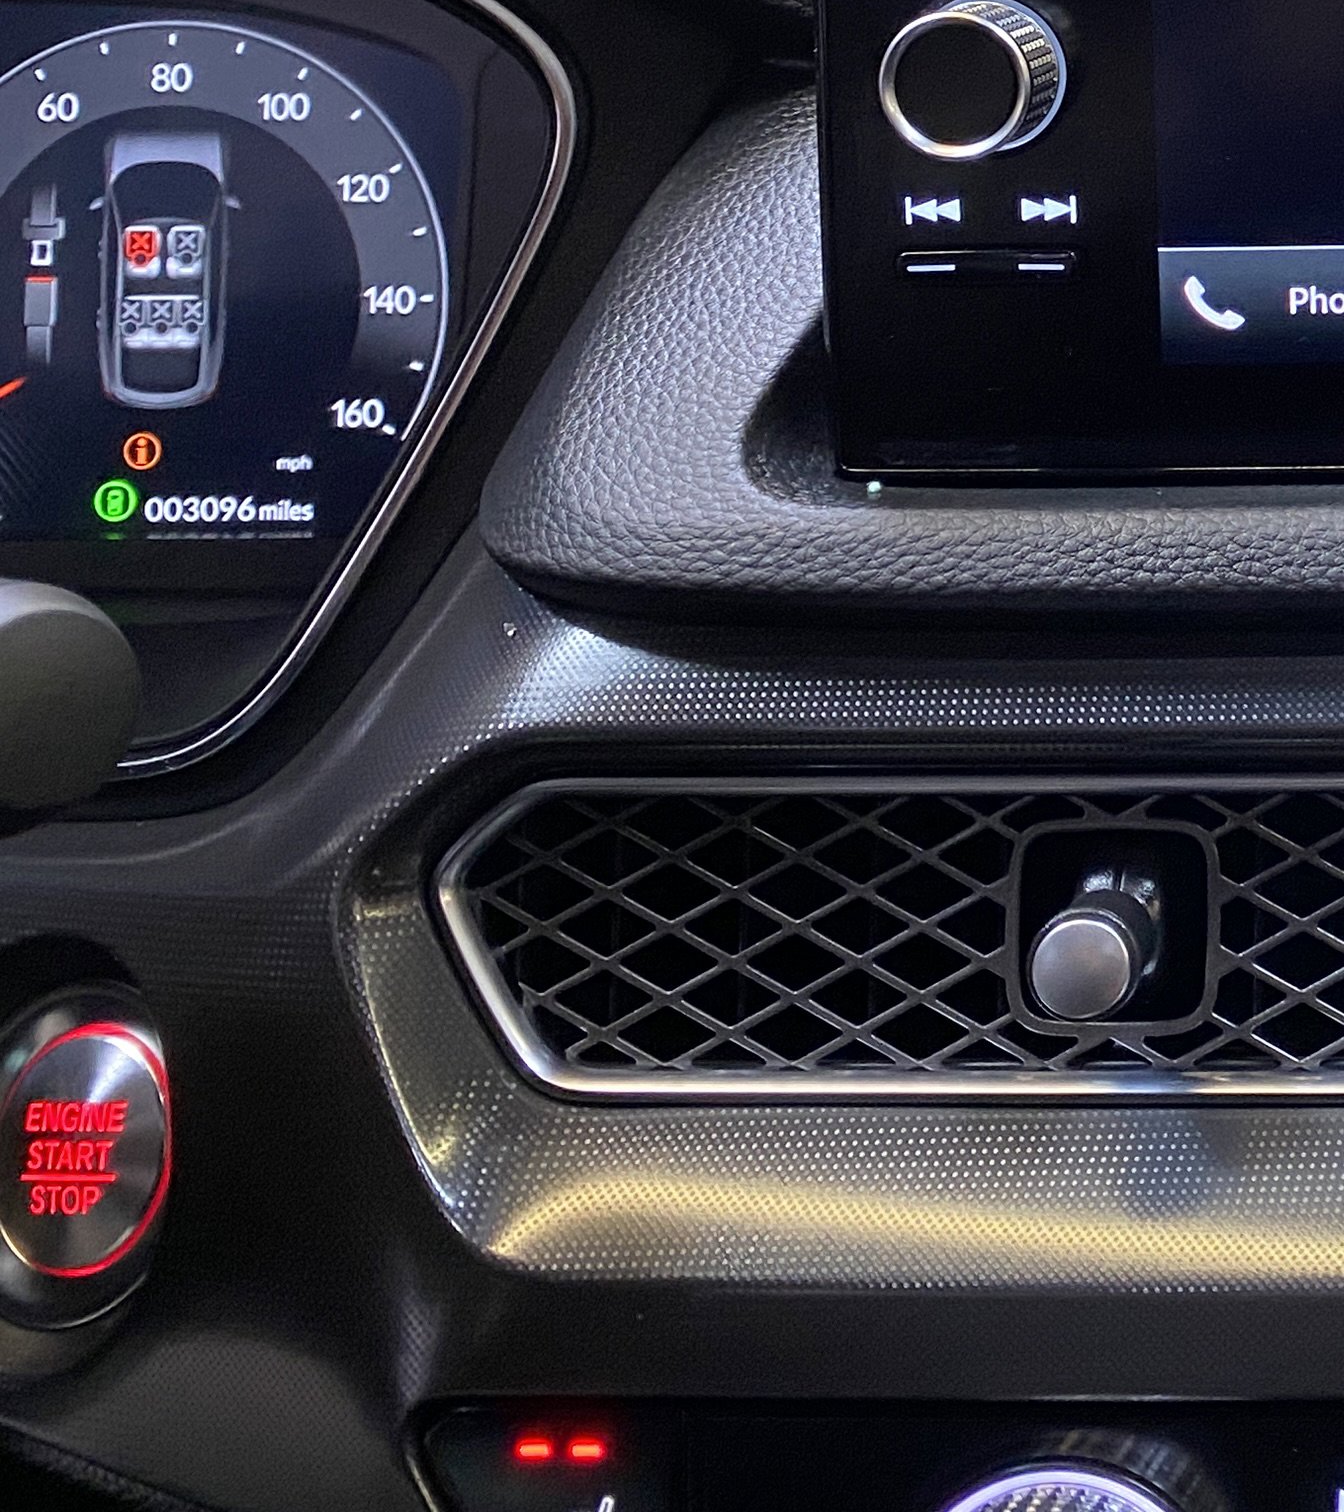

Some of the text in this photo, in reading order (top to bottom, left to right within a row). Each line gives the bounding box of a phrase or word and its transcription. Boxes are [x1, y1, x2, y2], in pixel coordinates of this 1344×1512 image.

[150, 62, 194, 93] 80
[37, 92, 80, 122] 60
[257, 92, 311, 122] 100
[337, 174, 389, 203] 120
[363, 286, 416, 314] 140
[331, 399, 383, 428] 160
[275, 454, 313, 473] mph
[144, 495, 315, 523] 003096 miles
[24, 1100, 128, 1133] ENGINE
[27, 1141, 113, 1170] START
[29, 1186, 102, 1215] STOP
